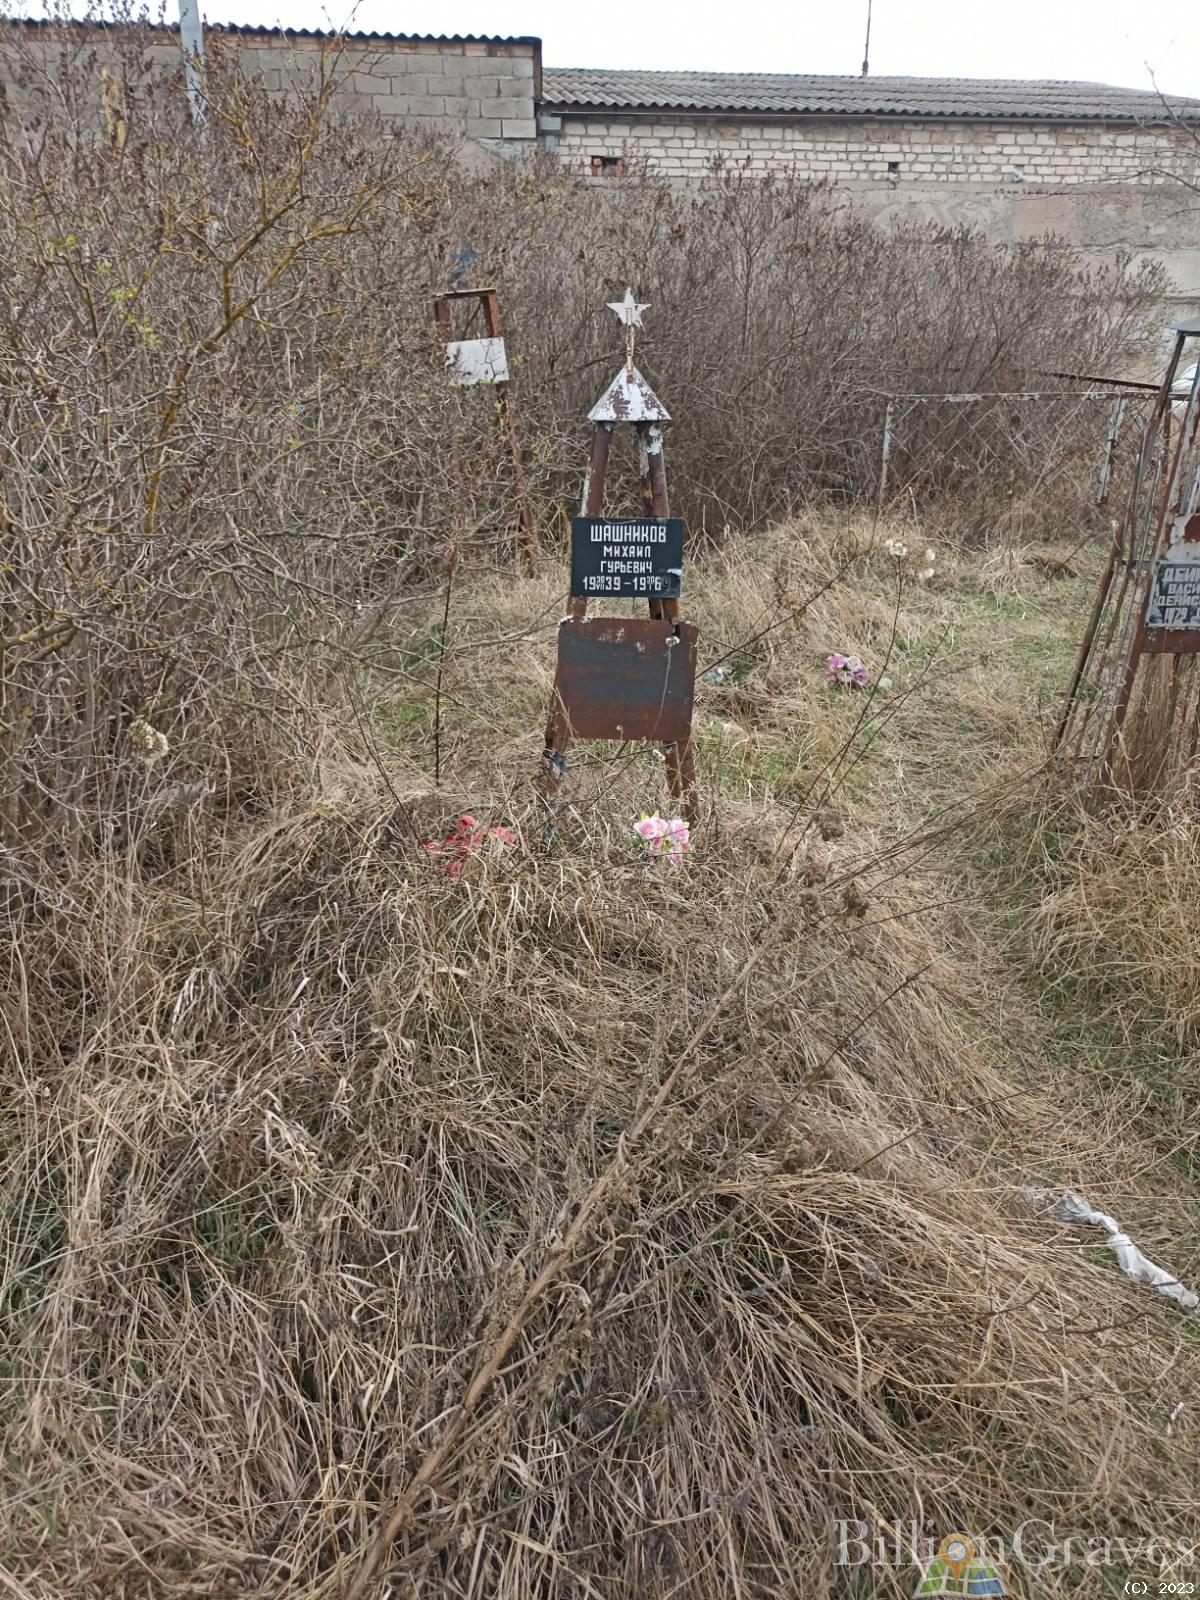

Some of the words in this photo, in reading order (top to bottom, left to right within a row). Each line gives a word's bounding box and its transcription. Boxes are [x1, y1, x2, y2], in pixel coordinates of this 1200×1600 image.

[590, 524, 667, 543] ШАШНИКОВ
[603, 545, 651, 558] МИХАИЛ
[600, 561, 653, 574] ГУРЬЕВИЧ
[1157, 595, 1200, 606] ДЕНИС
